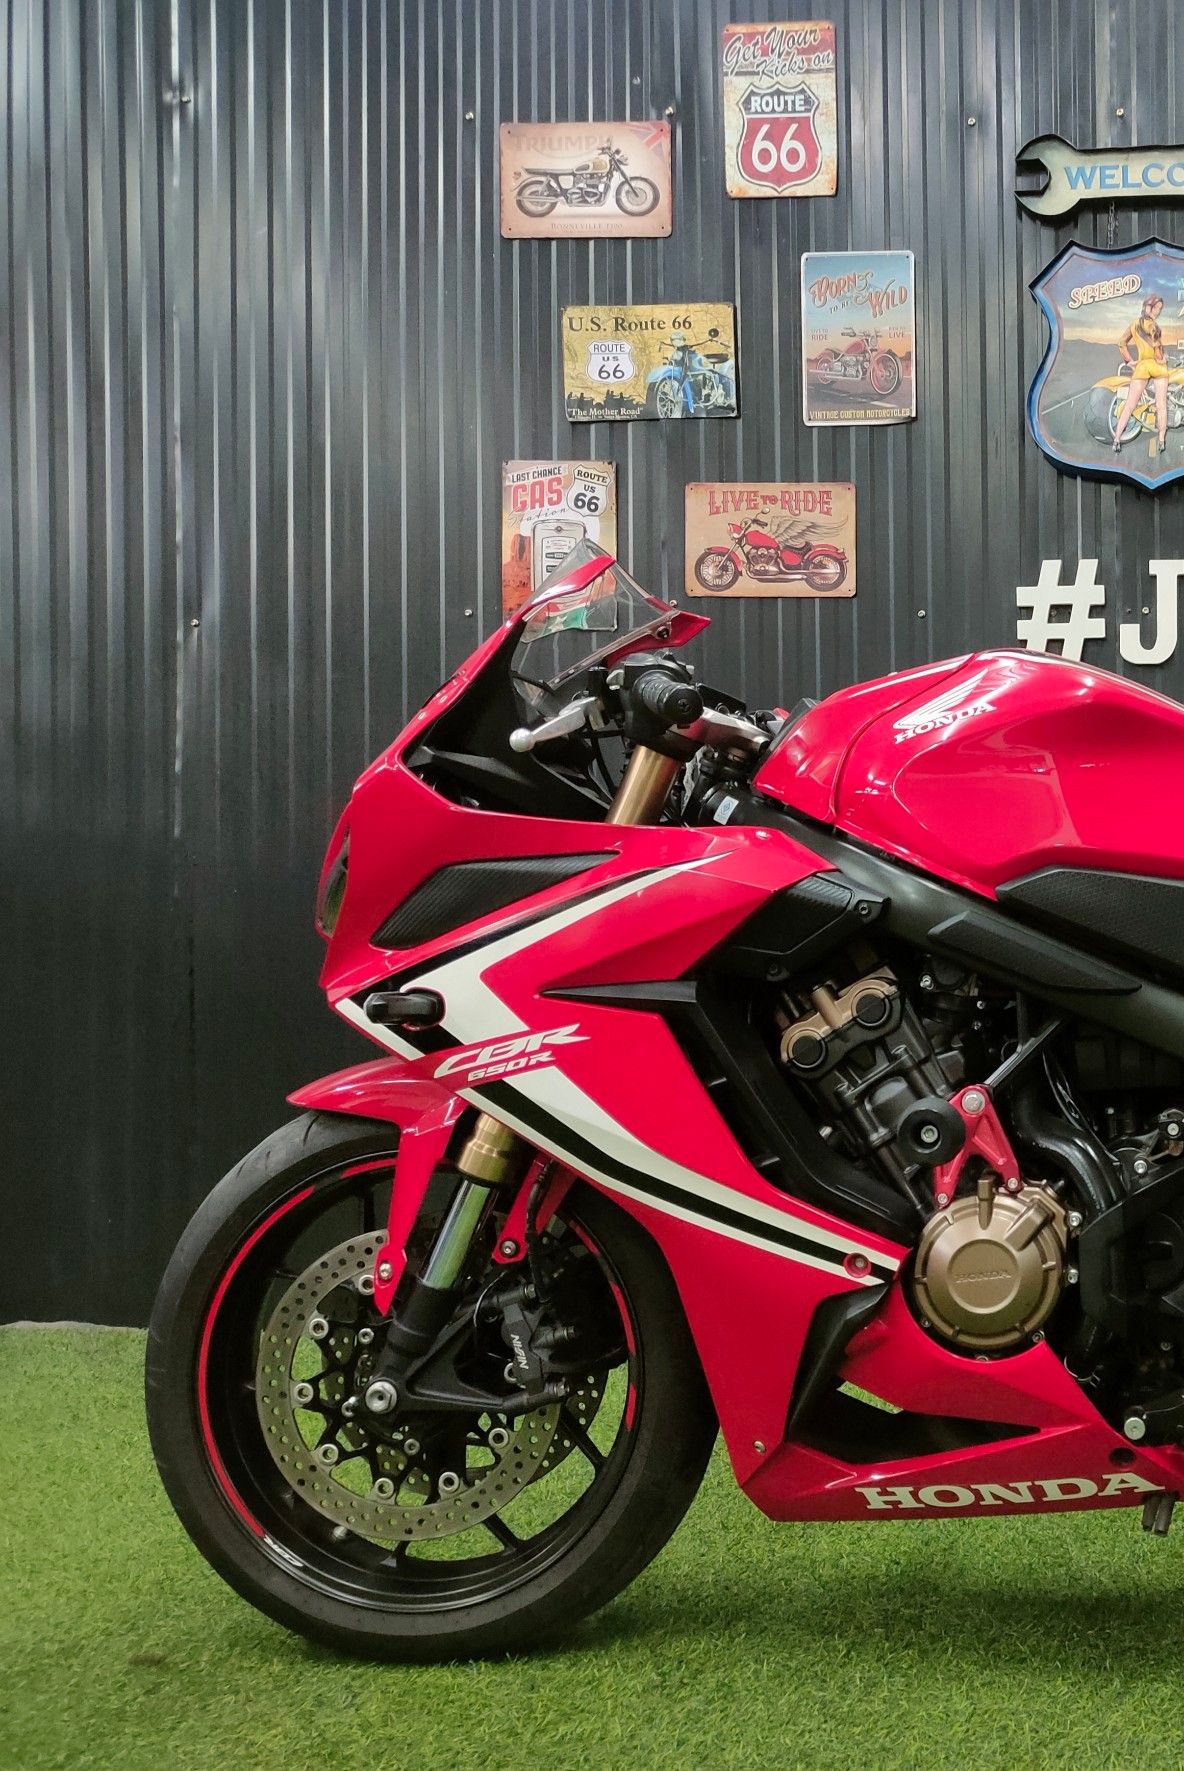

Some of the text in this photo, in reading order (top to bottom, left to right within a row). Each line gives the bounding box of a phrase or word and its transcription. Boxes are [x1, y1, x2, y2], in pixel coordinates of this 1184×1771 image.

[724, 26, 820, 76] Get Your
[756, 50, 833, 82] Kicks on
[751, 95, 806, 113] ROUTE
[513, 135, 615, 152] TRIUMPH
[752, 123, 806, 173] 66
[551, 222, 602, 230] BONNEVILLE
[808, 271, 874, 308] BORN
[854, 279, 909, 319] WILD
[1068, 272, 1142, 310] SPEED
[568, 315, 693, 332] U.S. Route 66
[811, 333, 829, 342] RIDE
[889, 331, 906, 339] LIVE
[593, 343, 626, 353] ROUTE
[597, 363, 626, 380] 66
[589, 407, 619, 416] Mother
[809, 407, 911, 420] VINTAGE CUSTOM MOTORCYCLES
[511, 465, 563, 483] LAST CHANCE
[576, 469, 608, 484] ROUTE
[512, 476, 563, 513] GAS
[583, 484, 596, 494] US
[573, 492, 601, 513] 66
[708, 490, 833, 517] LIVE TO RIDE
[507, 507, 571, 529] Station
[894, 701, 997, 745] HONDA
[433, 1022, 592, 1079] CBR
[467, 1050, 556, 1082] 650R
[955, 1269, 1013, 1285] HONDA
[510, 1333, 529, 1370] NISSIN
[854, 1472, 1166, 1510] HONDA
